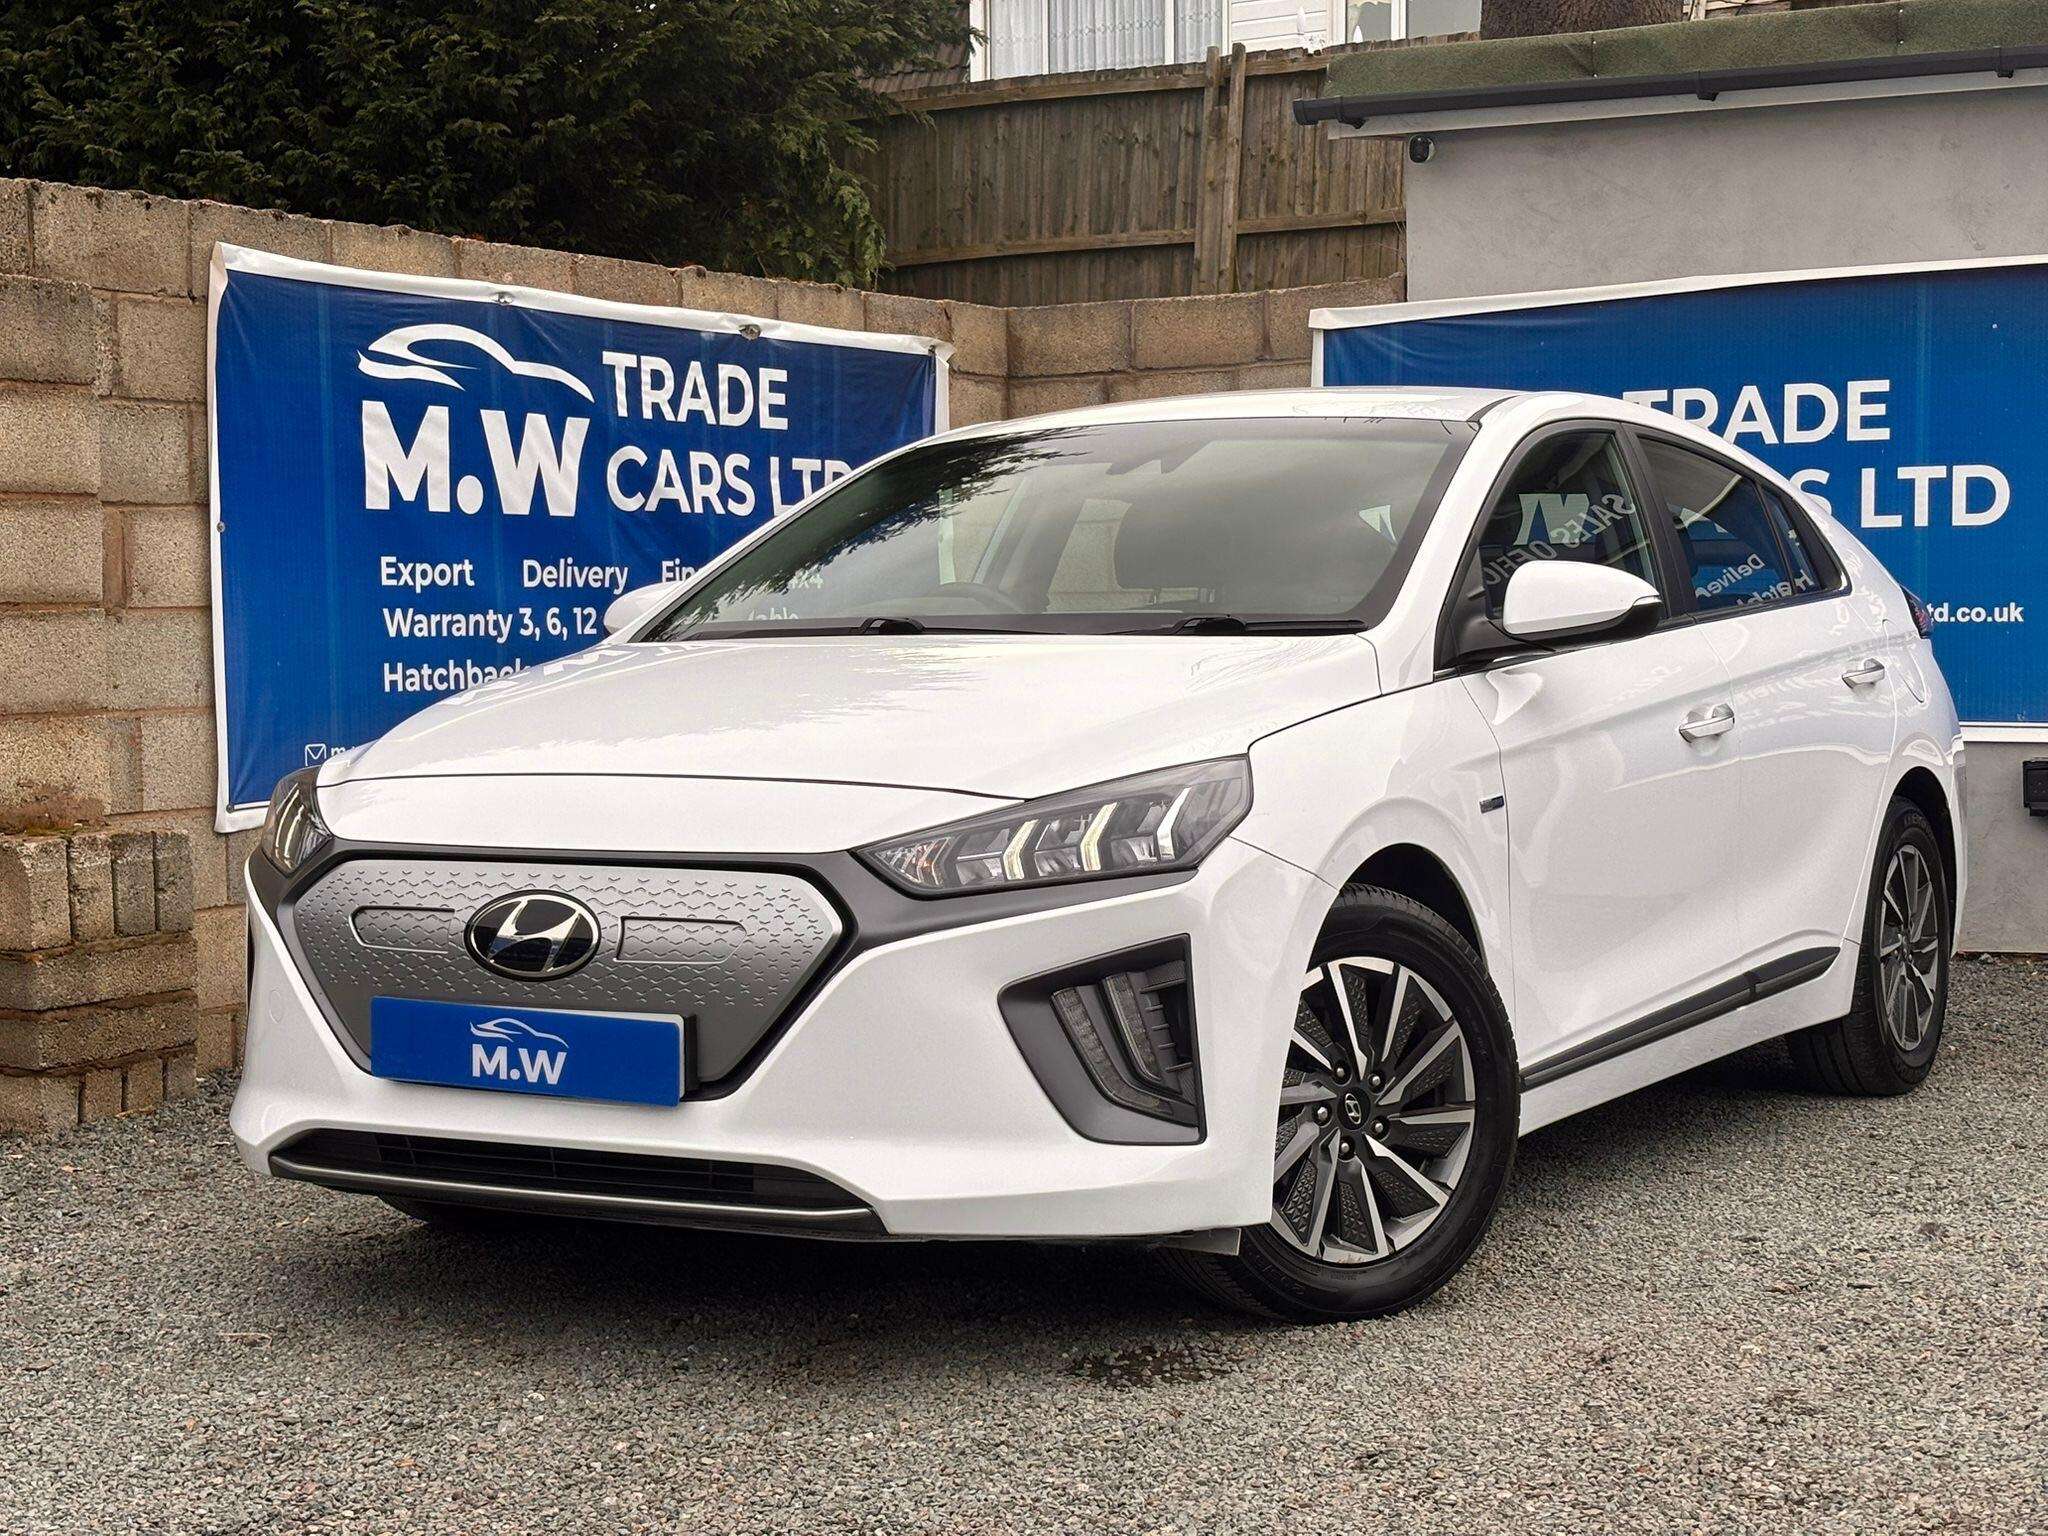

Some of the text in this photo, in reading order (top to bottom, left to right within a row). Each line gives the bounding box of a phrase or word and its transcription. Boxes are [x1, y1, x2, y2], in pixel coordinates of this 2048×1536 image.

[602, 350, 789, 430] TRADE
[362, 400, 590, 517] M.W
[606, 445, 756, 517] CARS
[1860, 464, 2011, 529] LTD
[380, 556, 697, 595] Export Delivery Fin
[383, 606, 598, 644] Warranty 3, 6, 12
[1926, 602, 2025, 623] td.co.uk
[472, 1043, 568, 1085] M.W
